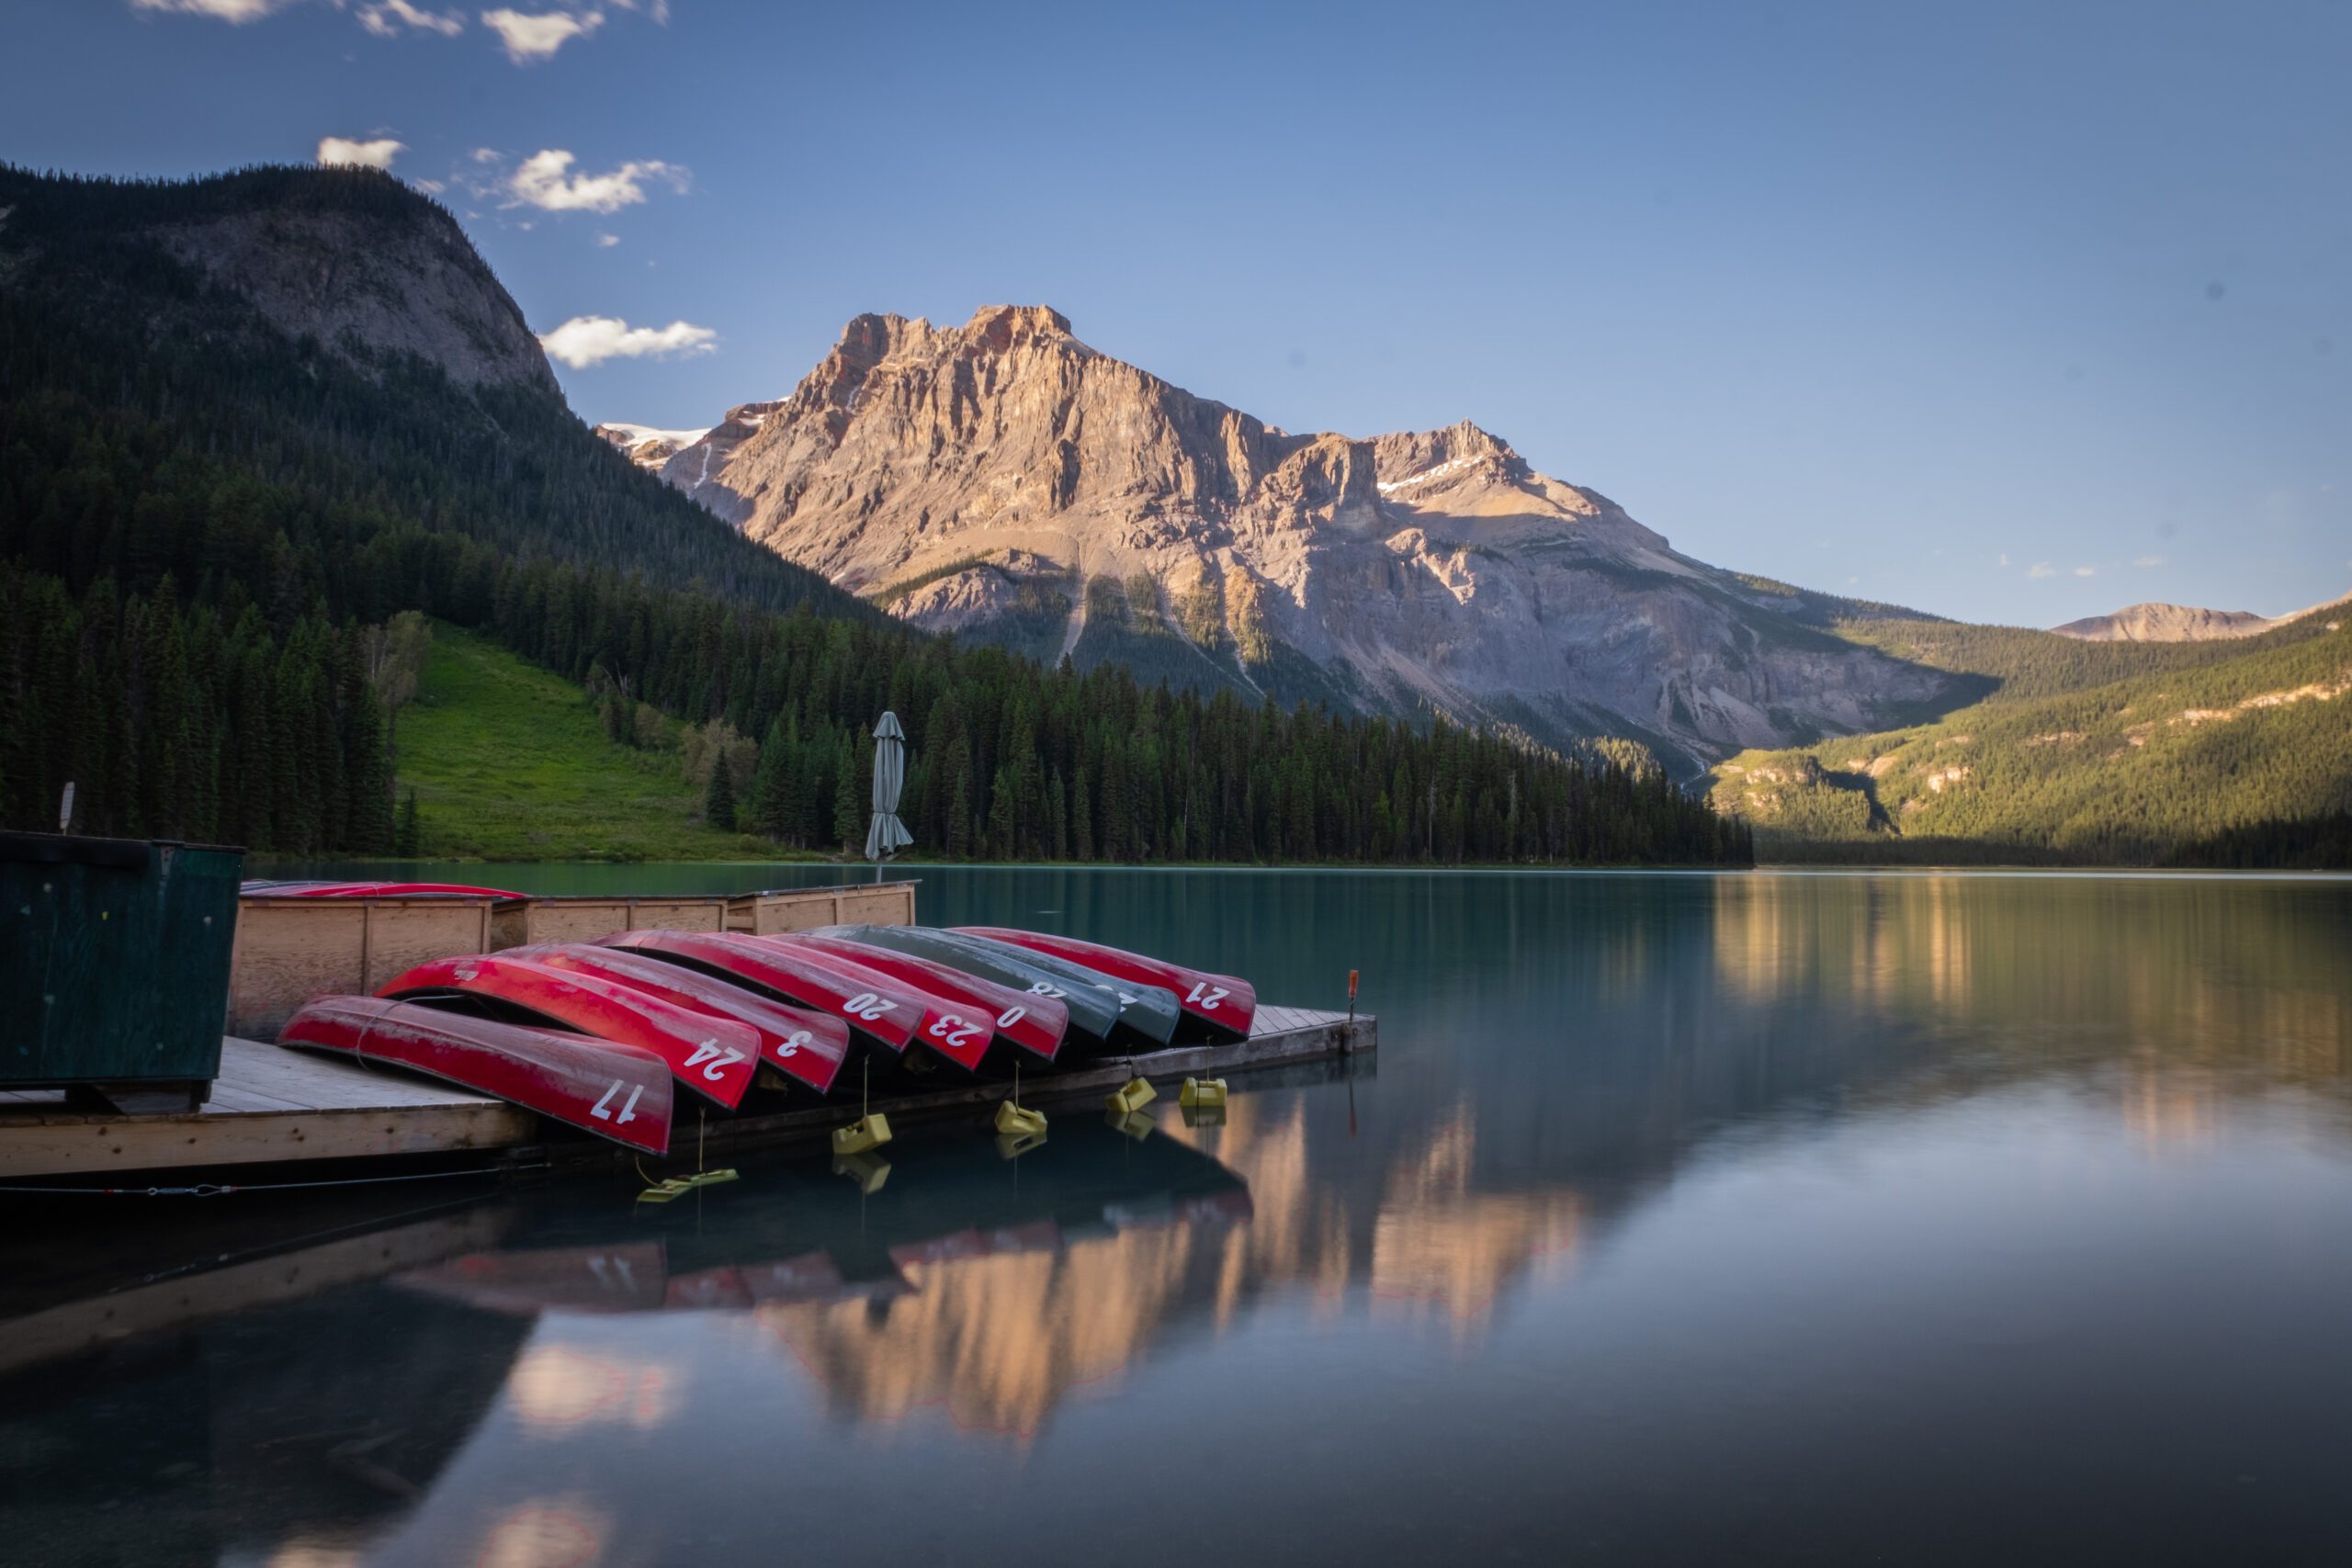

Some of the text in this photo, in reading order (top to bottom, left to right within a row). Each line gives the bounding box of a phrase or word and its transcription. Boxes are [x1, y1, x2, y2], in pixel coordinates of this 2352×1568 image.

[842, 993, 899, 1021] 20
[1185, 982, 1230, 1010] 21
[929, 1014, 984, 1047] 23
[997, 1006, 1027, 1028] 0
[776, 1031, 813, 1057] 3
[684, 1038, 746, 1081] 24
[590, 1079, 644, 1124] 17
